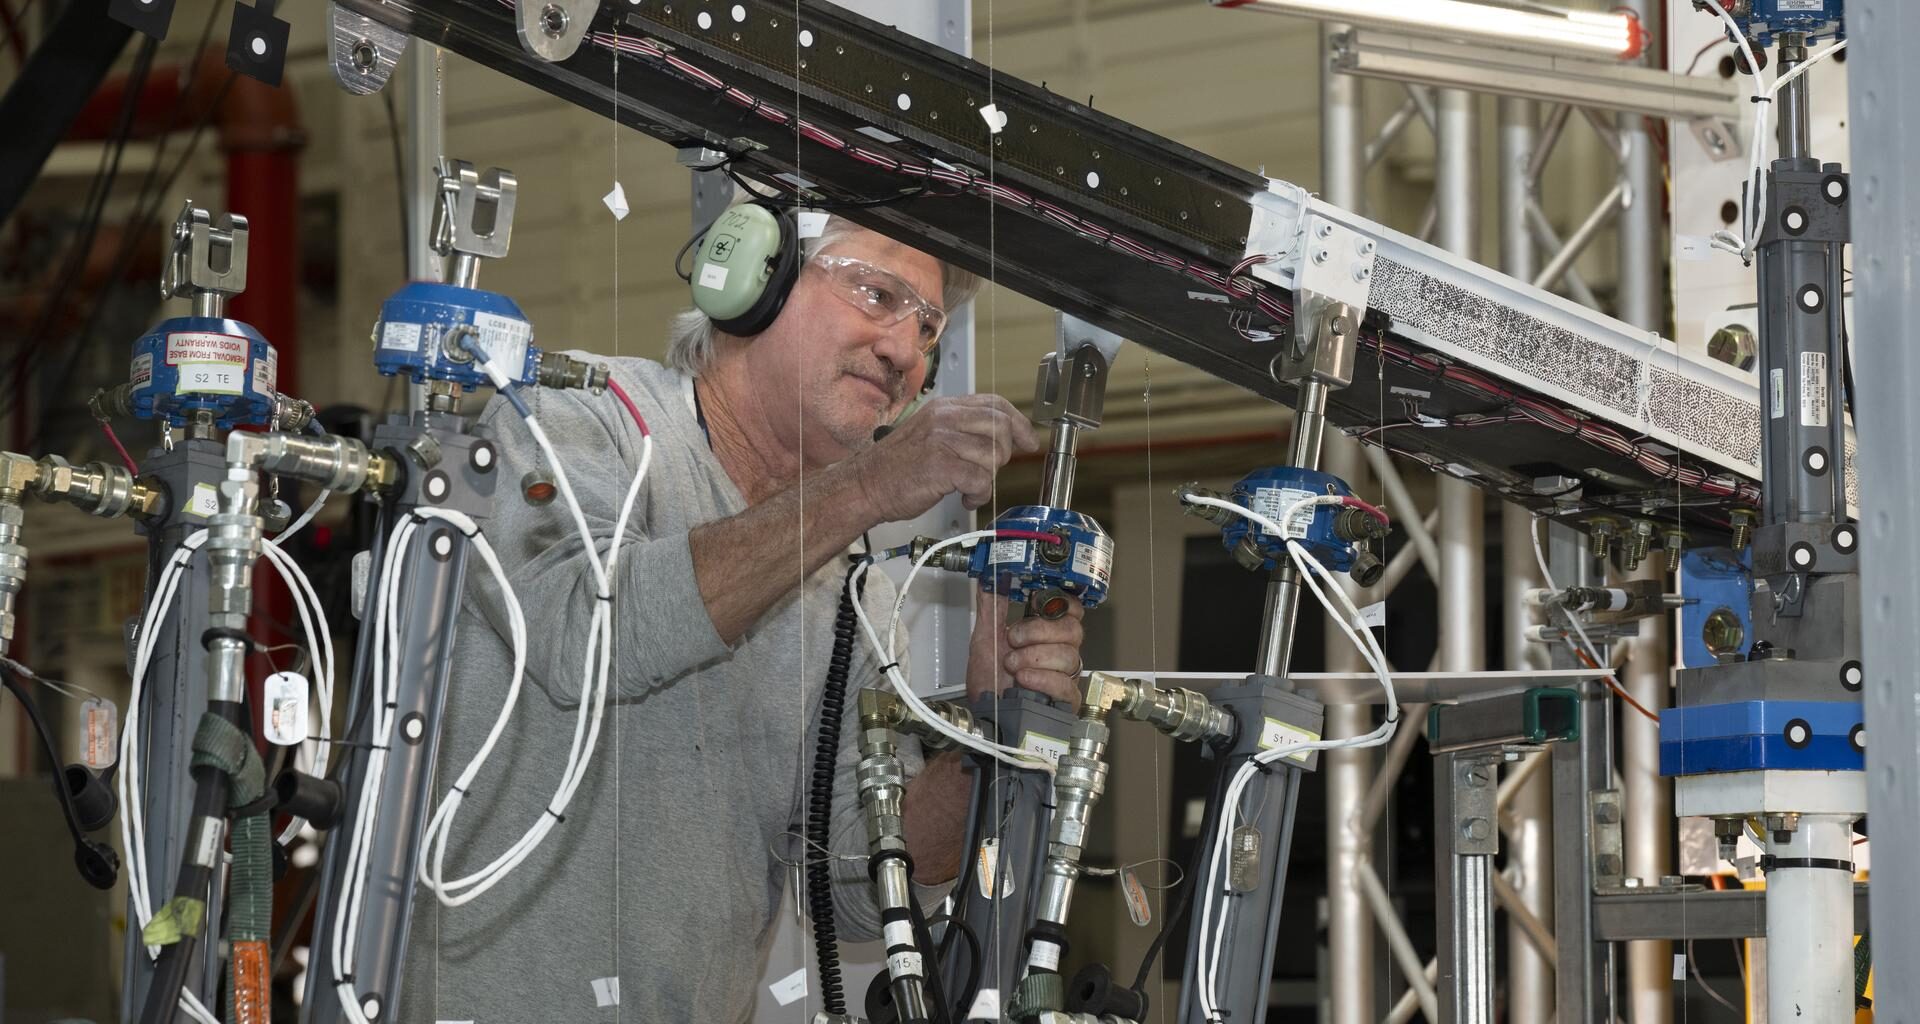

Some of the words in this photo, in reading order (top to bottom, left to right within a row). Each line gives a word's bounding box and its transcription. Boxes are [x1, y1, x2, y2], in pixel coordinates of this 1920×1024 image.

[175, 338, 218, 348] WARRANTY
[219, 341, 241, 351] VOIDS
[169, 350, 188, 359] BASE
[190, 350, 211, 359] FROM
[213, 351, 246, 364] REMOVAL
[195, 373, 209, 383] S2
[216, 374, 230, 384] TE
[204, 498, 217, 510] S2
[1273, 733, 1284, 744] S1
[1049, 749, 1058, 760] TE
